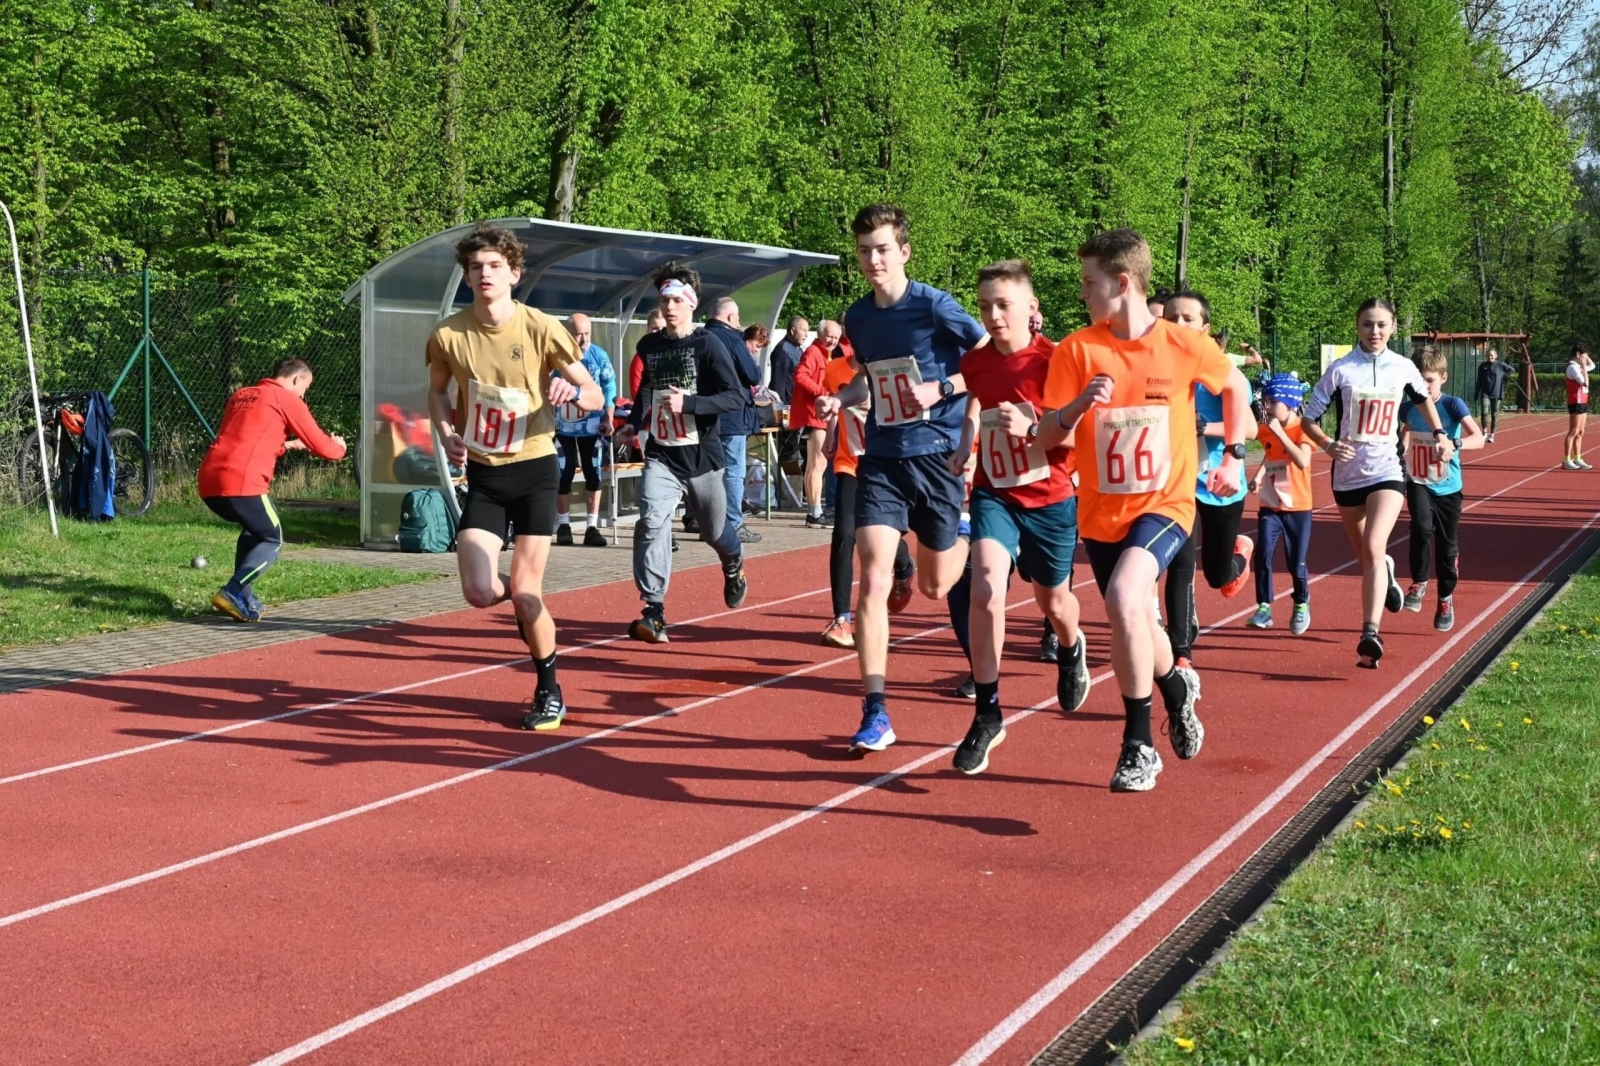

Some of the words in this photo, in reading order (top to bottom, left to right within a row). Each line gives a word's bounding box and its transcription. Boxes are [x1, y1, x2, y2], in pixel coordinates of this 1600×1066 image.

[656, 403, 688, 440] 60
[878, 373, 918, 423] 50
[1356, 398, 1396, 436] 108
[473, 402, 517, 452] 181
[989, 429, 1030, 479] 68
[1106, 426, 1155, 485] 66
[1412, 444, 1442, 479] 104
